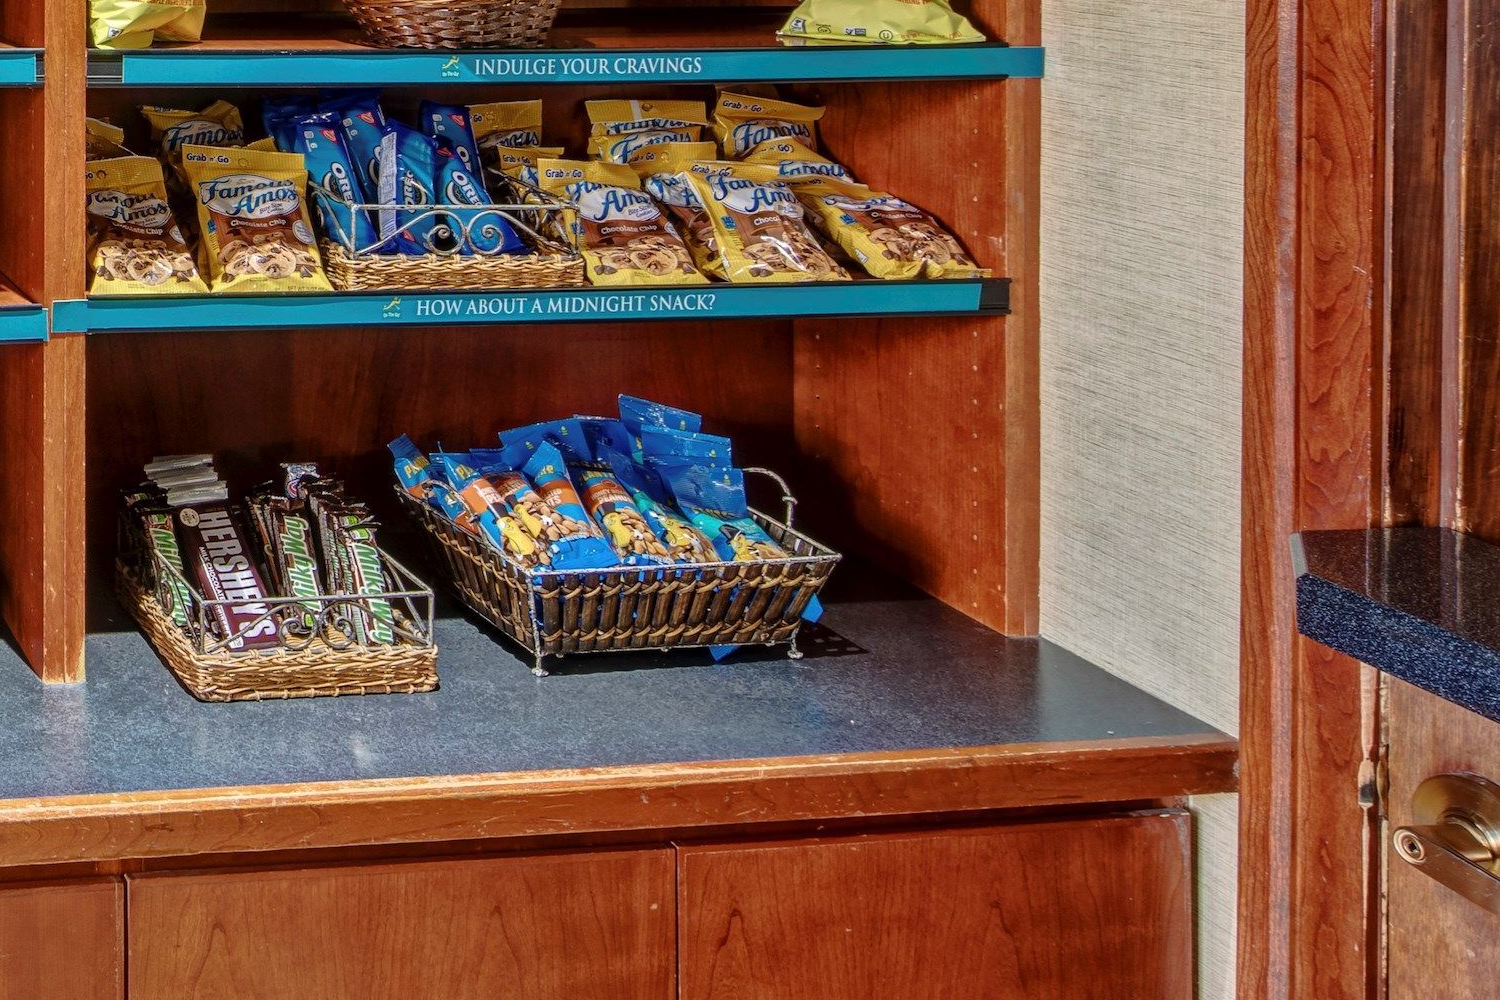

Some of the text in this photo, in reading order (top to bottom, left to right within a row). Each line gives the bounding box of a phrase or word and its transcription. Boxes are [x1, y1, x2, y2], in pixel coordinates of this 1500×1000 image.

[475, 57, 702, 76] INDULGE YOUR CRAVINGS
[723, 100, 761, 113] Grab Go
[733, 122, 810, 153] Famous
[186, 153, 207, 162] Grab
[218, 155, 230, 163] Go
[546, 169, 582, 178] Grab Go
[200, 179, 294, 205] Famous
[226, 187, 297, 215] Amos
[231, 218, 286, 228] Chocolate Chip
[416, 294, 716, 316] HOW ABOUT A MIDNIGHT SNACK?
[280, 516, 309, 556] Way
[199, 546, 226, 600] MILK CHOCOLATE
